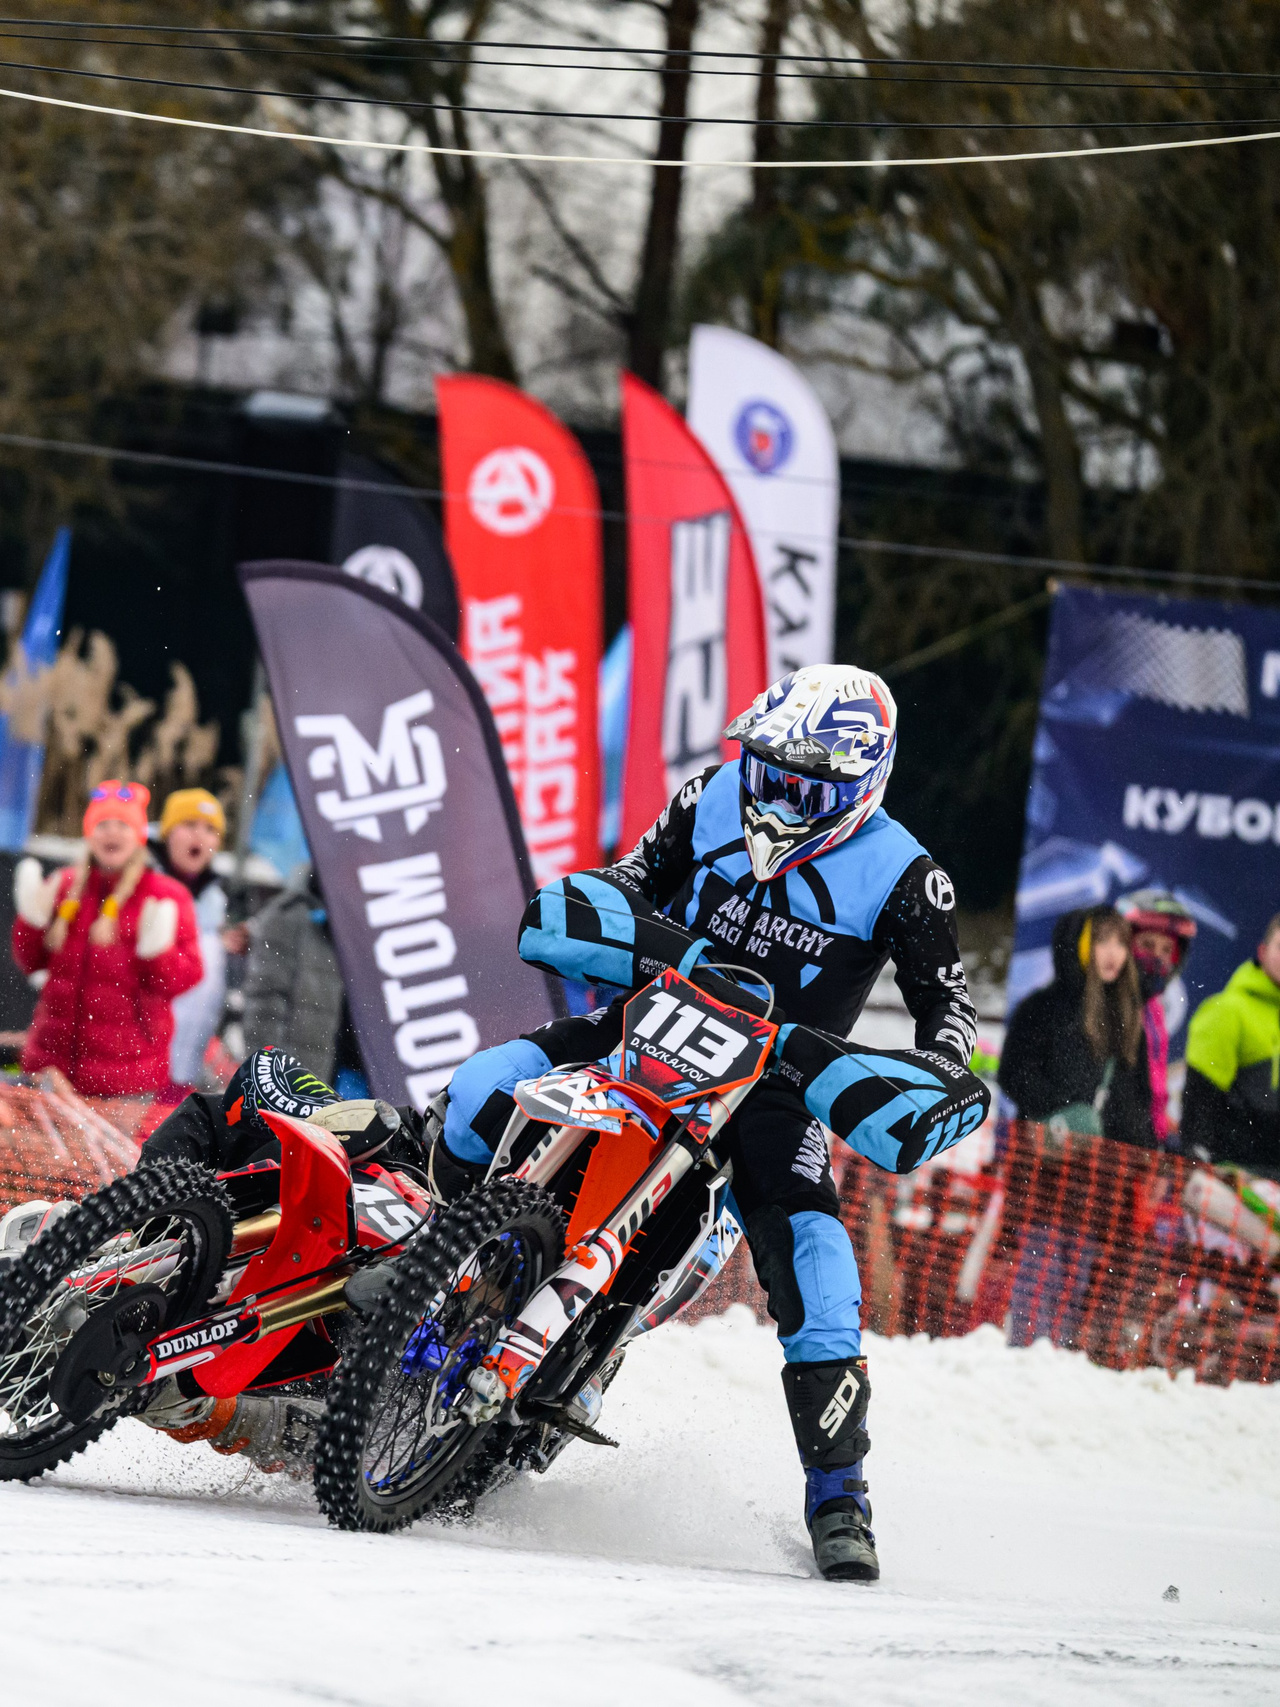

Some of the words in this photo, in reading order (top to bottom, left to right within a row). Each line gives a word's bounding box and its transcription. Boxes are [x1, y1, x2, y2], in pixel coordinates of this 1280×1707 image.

[1122, 783, 1280, 846] КУБО
[633, 991, 749, 1078] 113
[256, 1053, 300, 1115] MONSTER
[155, 1317, 239, 1359] DUNLOP
